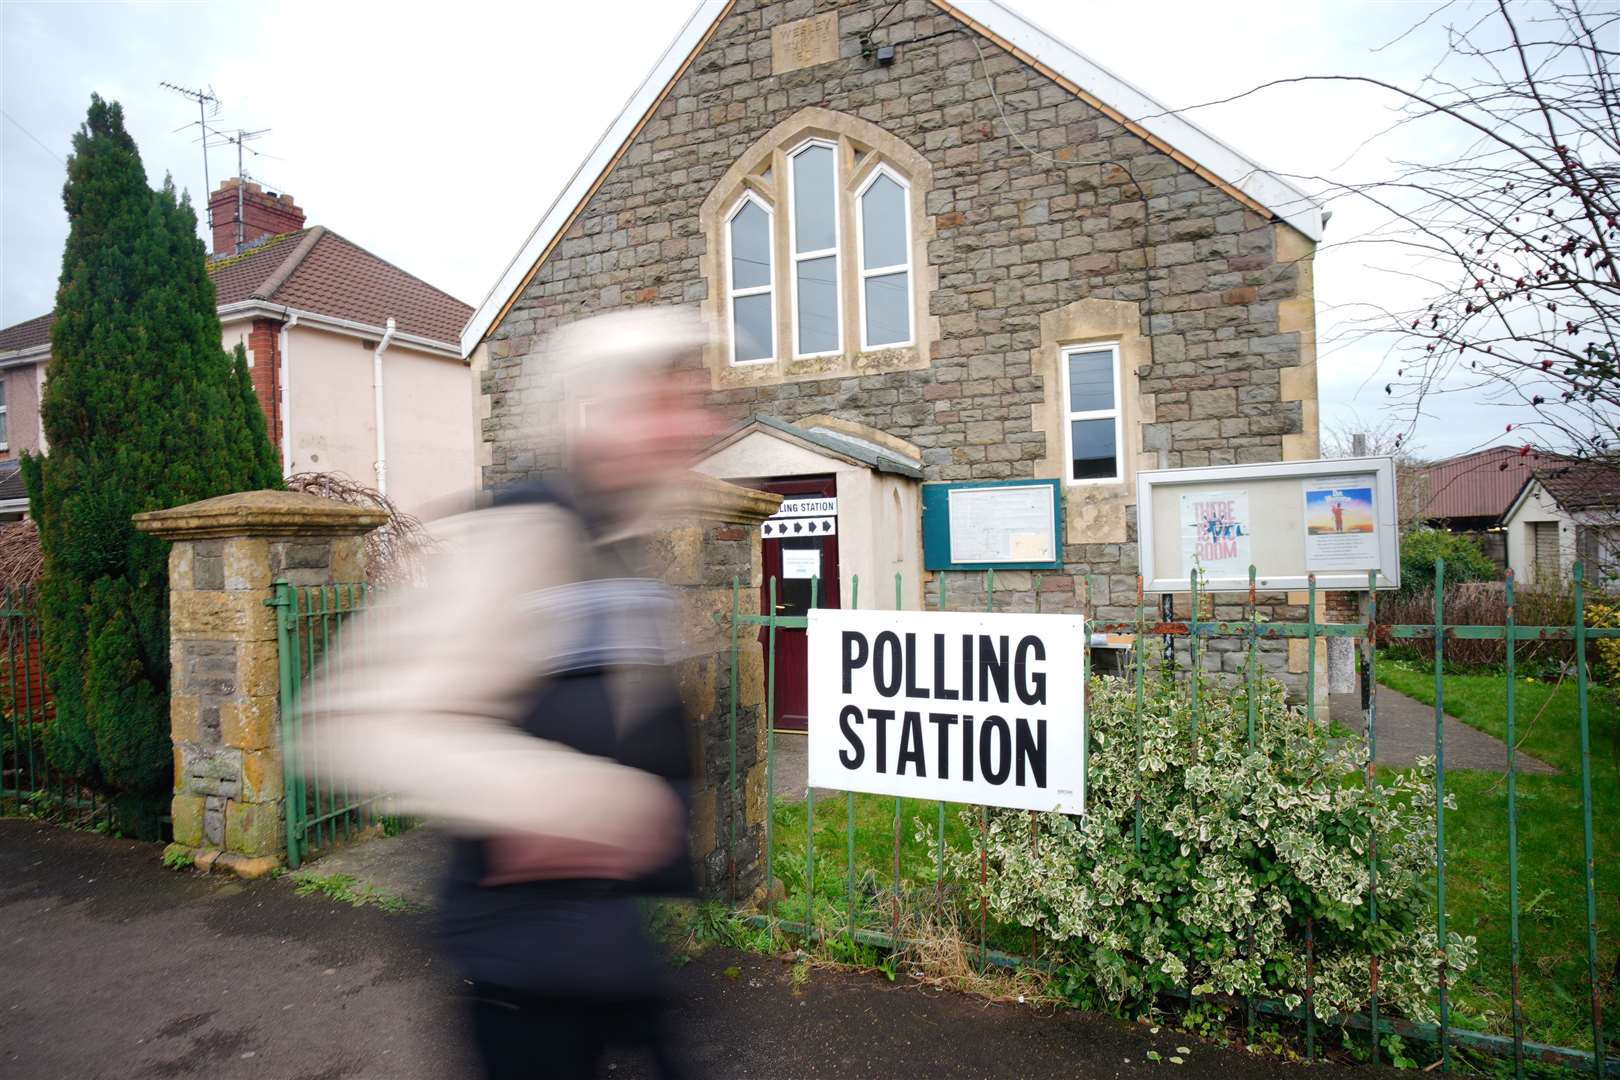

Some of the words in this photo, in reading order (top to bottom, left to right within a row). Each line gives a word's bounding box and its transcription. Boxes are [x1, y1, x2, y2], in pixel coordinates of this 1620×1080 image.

[779, 504, 798, 513] LING
[800, 502, 834, 512] STATION
[1192, 500, 1236, 522] THERE
[1195, 541, 1238, 561] ROOM
[841, 630, 1047, 705] POLLING
[838, 704, 1047, 789] STATION
